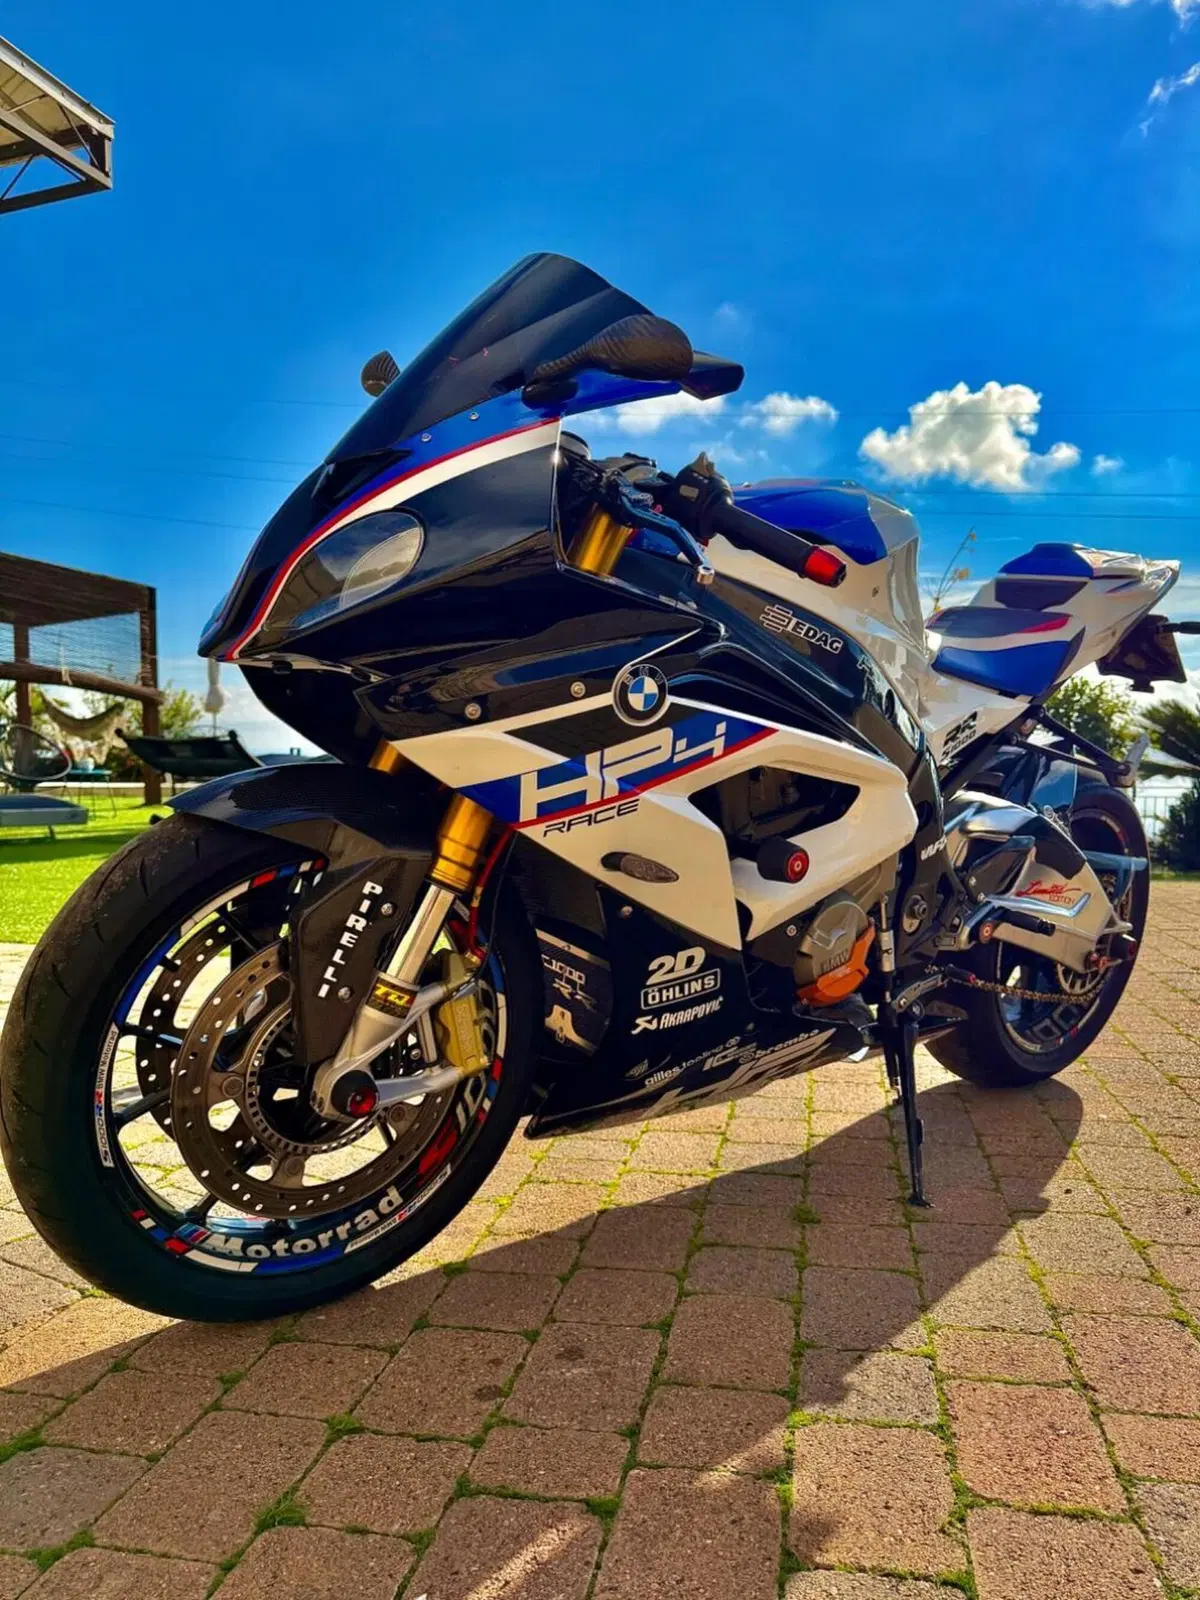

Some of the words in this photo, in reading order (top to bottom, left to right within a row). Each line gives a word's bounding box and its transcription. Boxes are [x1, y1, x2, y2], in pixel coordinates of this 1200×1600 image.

[792, 621, 843, 654] EDAG
[622, 665, 665, 685] BMW
[518, 721, 727, 823] HP4
[543, 798, 640, 838] RACE
[318, 881, 383, 998] PIRELLI
[646, 946, 706, 985] 2D
[648, 975, 715, 1005] ÖHLINS
[201, 1184, 404, 1260] Motorrad
